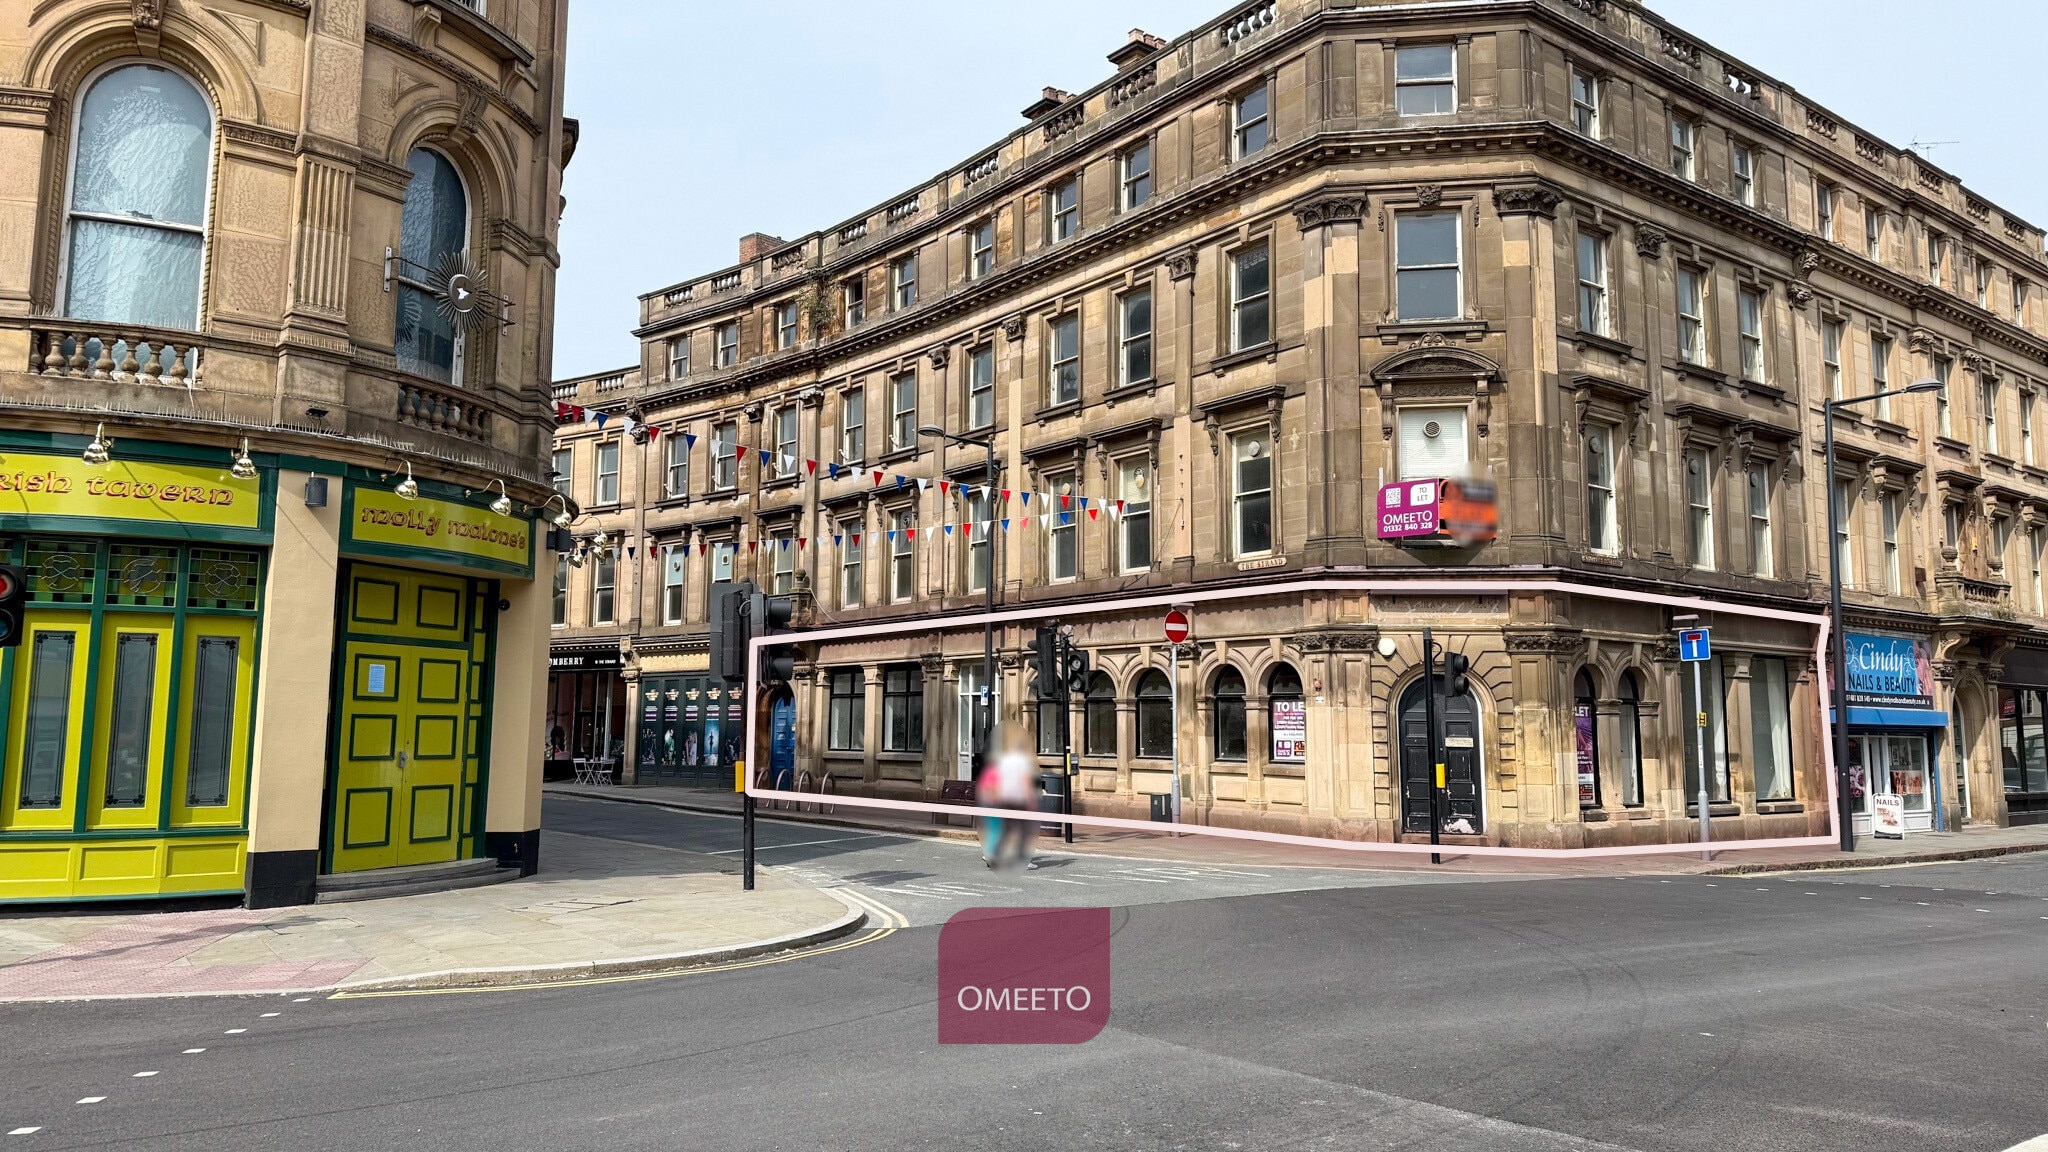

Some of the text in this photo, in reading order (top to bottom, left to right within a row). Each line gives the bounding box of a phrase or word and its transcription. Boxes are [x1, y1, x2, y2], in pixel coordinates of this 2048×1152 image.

[361, 507, 441, 536] molly
[1383, 510, 1433, 525] OMEETO
[1420, 521, 1433, 529] 328
[1257, 559, 1283, 568] STRAND
[1859, 640, 1905, 684] Cindy
[1848, 673, 1916, 693] NAILS & BEAUTY
[983, 687, 988, 697] P
[1275, 701, 1305, 712] TO LE
[1876, 799, 1900, 807] NAILS
